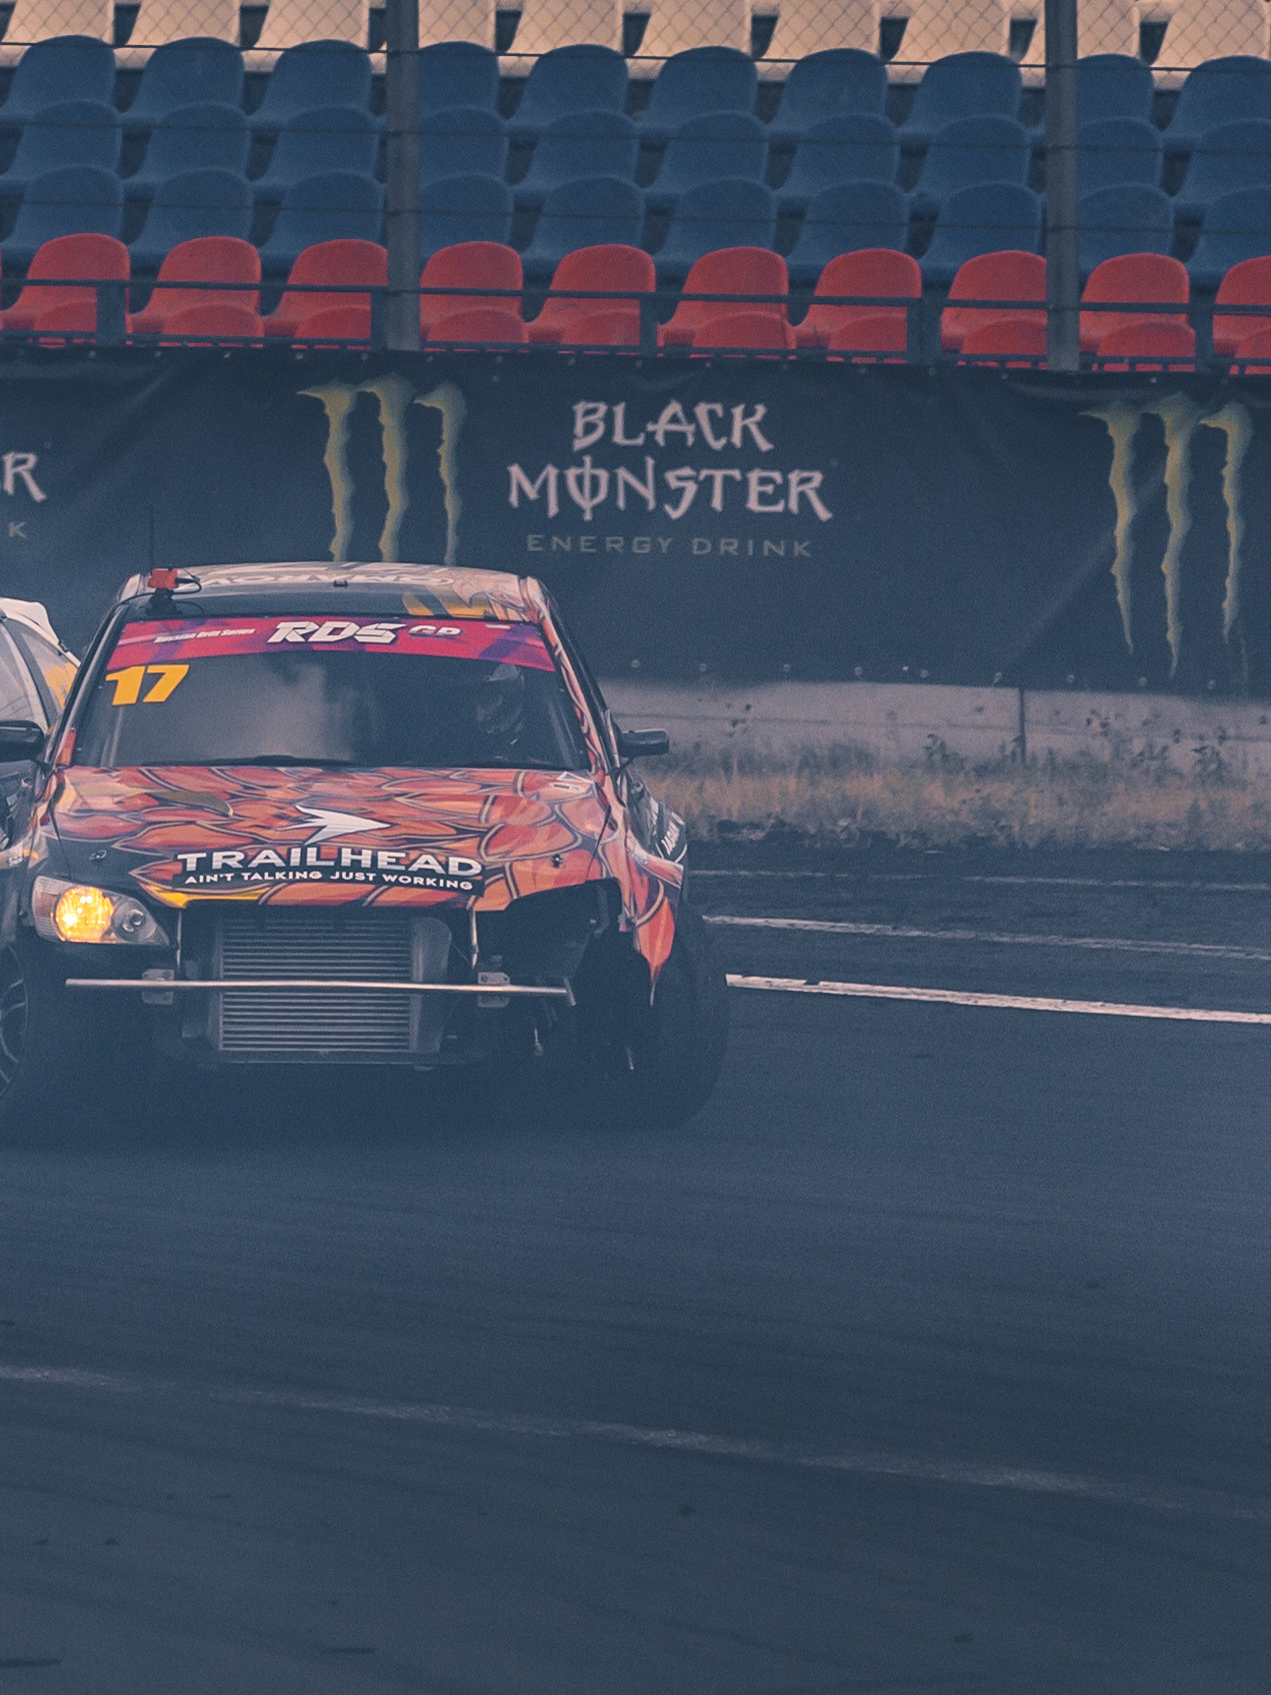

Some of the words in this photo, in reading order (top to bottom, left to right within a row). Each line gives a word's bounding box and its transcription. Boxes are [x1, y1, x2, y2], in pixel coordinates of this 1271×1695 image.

[572, 400, 775, 453] BLACK
[507, 455, 833, 522] MONSTER
[526, 532, 675, 557] ENERGY
[691, 537, 814, 559] DRINK
[266, 620, 408, 645] RDS
[408, 624, 462, 638] GP
[105, 663, 190, 706] 17
[177, 847, 483, 878] TRAILHEAD
[185, 872, 235, 885] AIN'T
[241, 870, 323, 882] TALKING
[330, 871, 378, 882] JUST
[382, 873, 473, 891] WORKING
